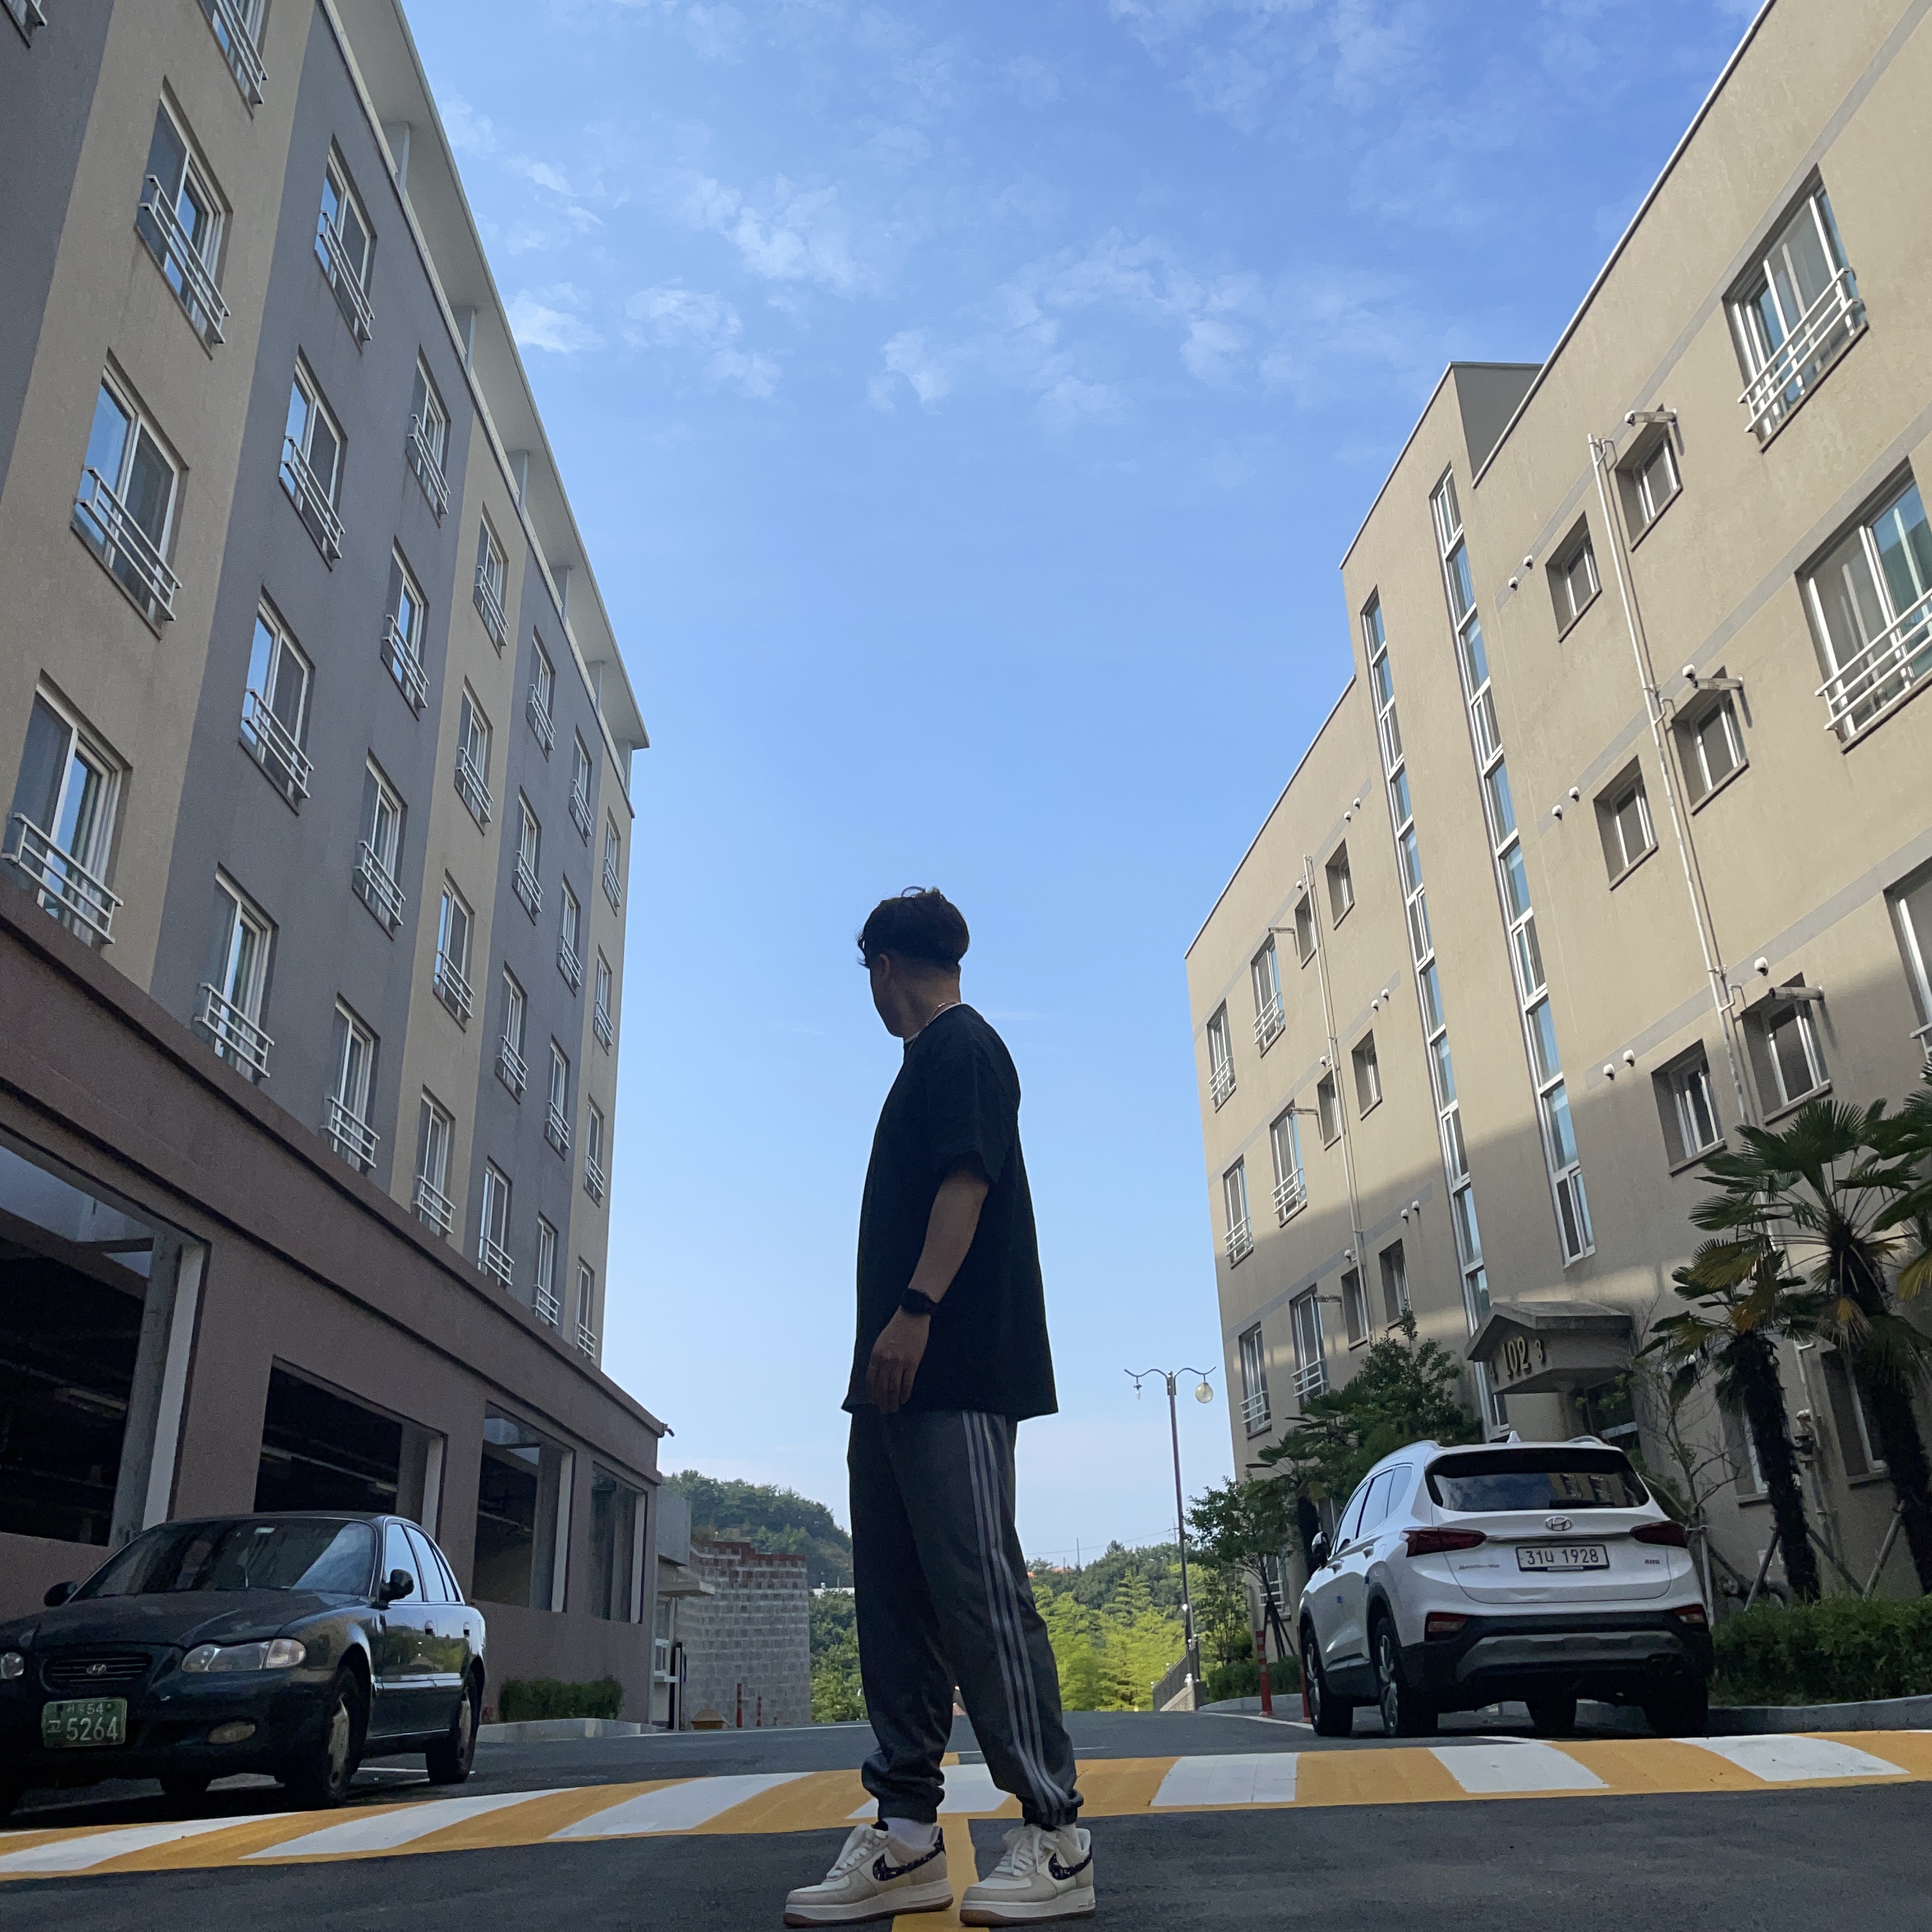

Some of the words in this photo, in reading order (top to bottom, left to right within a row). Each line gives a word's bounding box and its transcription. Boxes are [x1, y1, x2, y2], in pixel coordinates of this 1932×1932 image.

[1502, 1335, 1529, 1376] 102
[1561, 1549, 1599, 1564] 1928
[87, 1703, 103, 1715] 54
[66, 1716, 118, 1742] 5264
